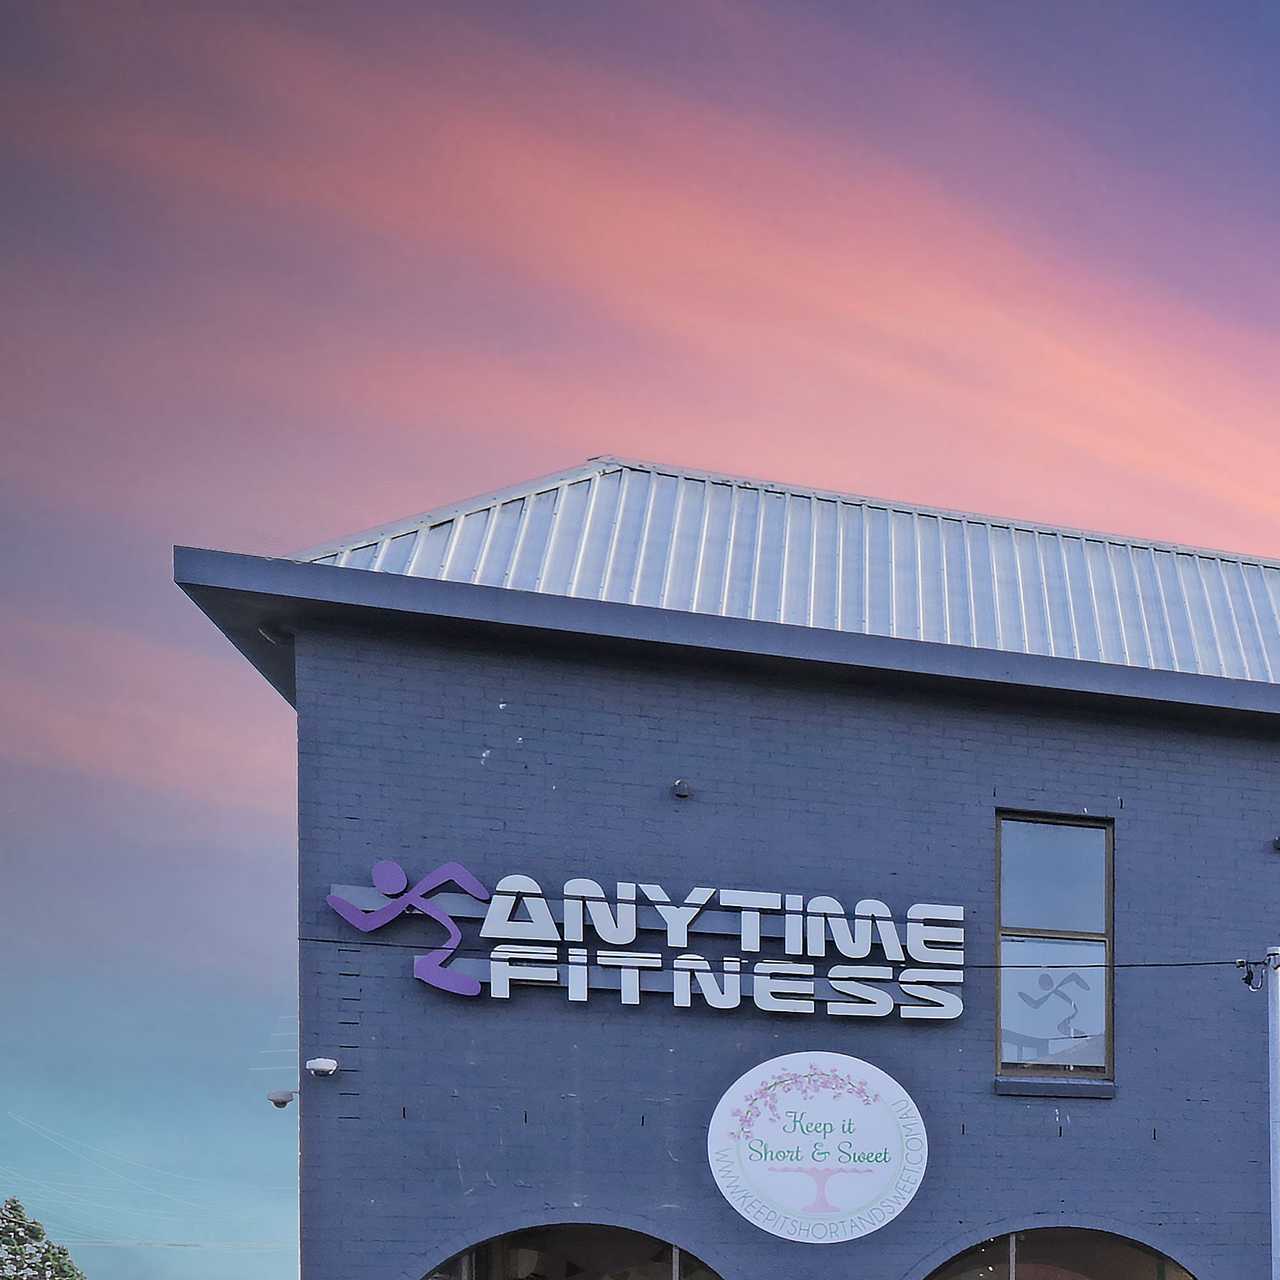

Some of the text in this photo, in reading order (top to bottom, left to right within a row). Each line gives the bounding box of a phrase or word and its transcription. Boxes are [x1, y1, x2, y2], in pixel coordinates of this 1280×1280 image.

[480, 874, 965, 965] ANYTIME
[490, 944, 965, 1020] FITNESS
[748, 1138, 891, 1164] Short & Sweet
[782, 1111, 856, 1139] Keep it
